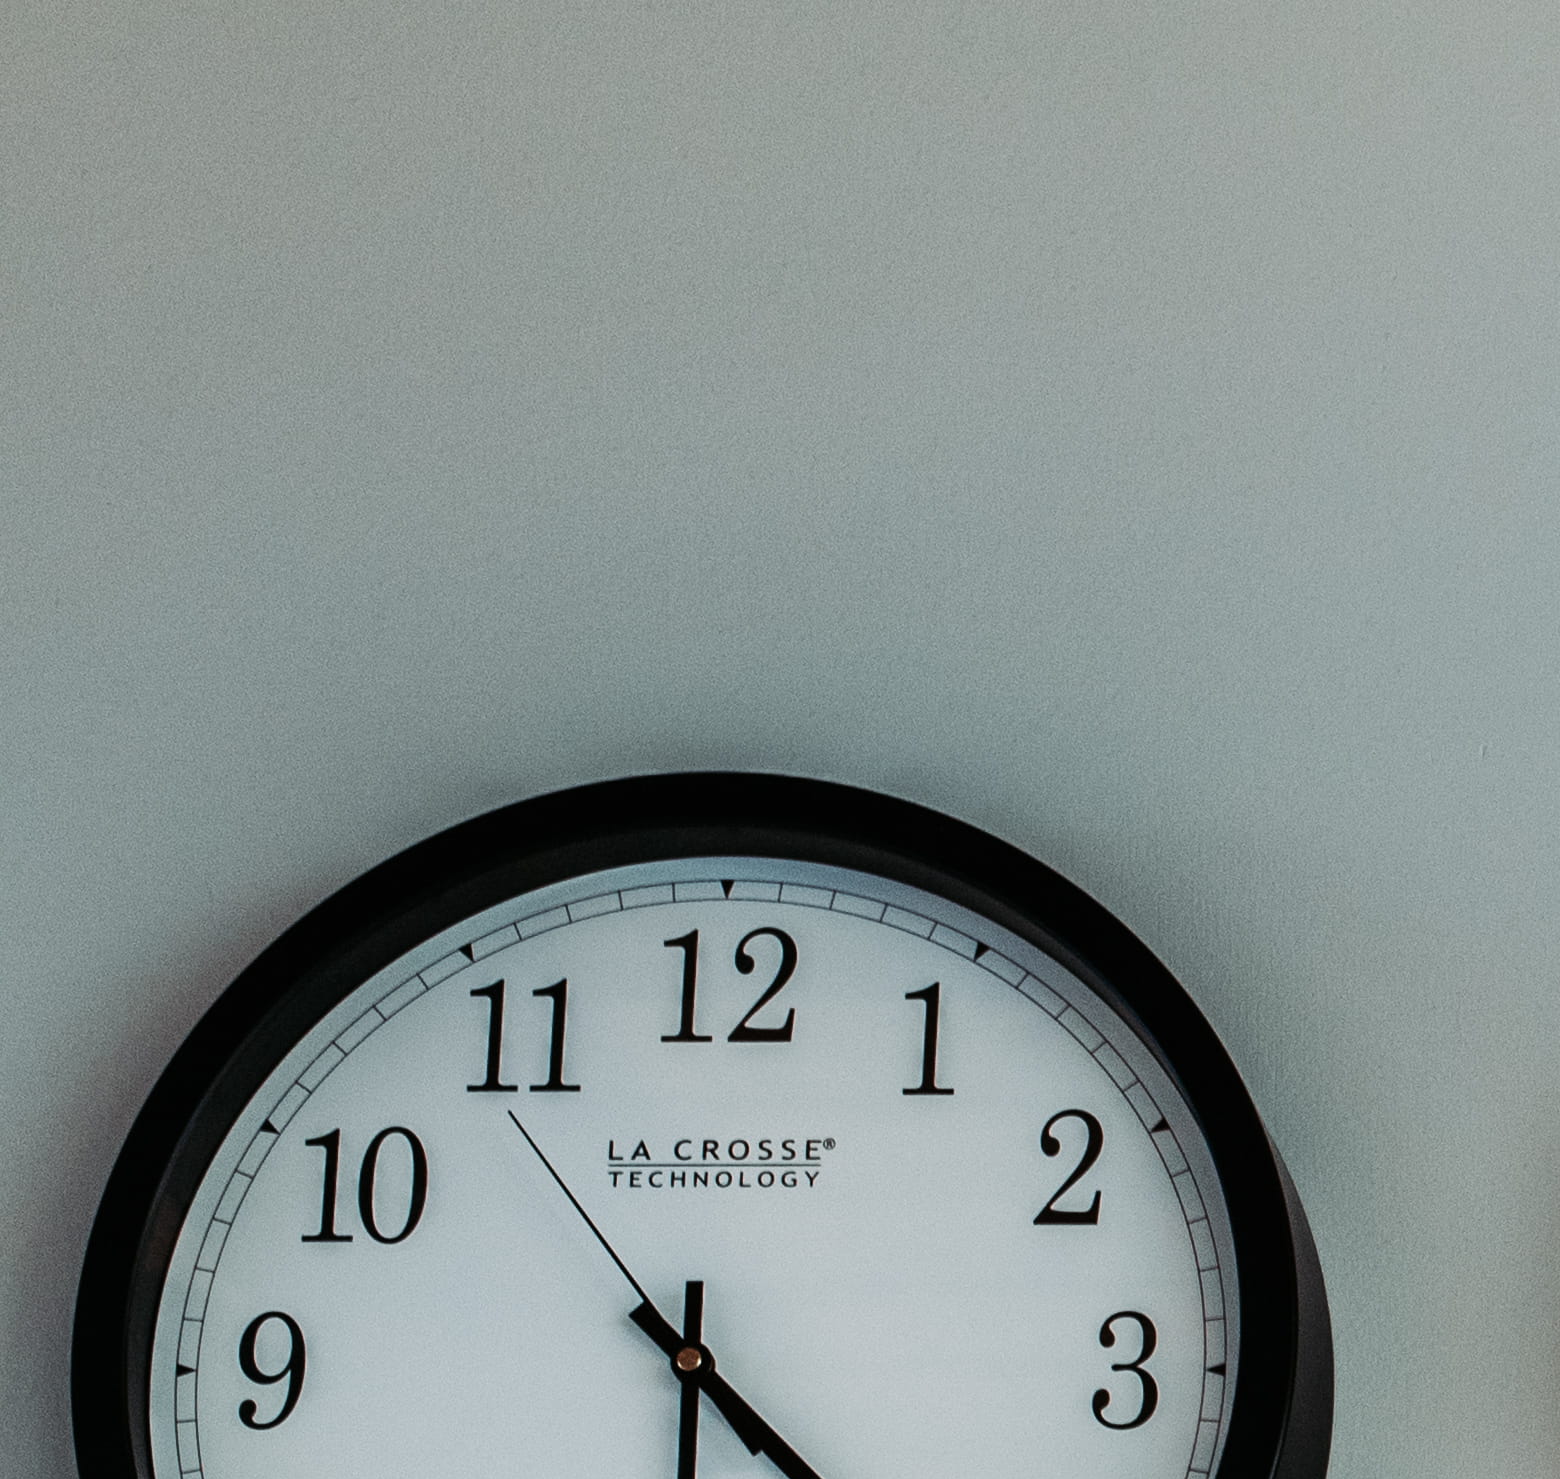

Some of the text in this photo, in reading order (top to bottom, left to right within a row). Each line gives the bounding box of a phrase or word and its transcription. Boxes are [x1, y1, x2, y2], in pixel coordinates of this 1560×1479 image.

[467, 978, 581, 1092] 11
[661, 927, 797, 1042] 12
[903, 982, 954, 1095] 1
[301, 1126, 427, 1244] 10
[608, 1139, 651, 1161] LA
[608, 1171, 820, 1188] TECHNOLOGY
[1033, 1109, 1103, 1225] 2
[239, 1311, 305, 1430] 9
[1092, 1311, 1158, 1430] 3
